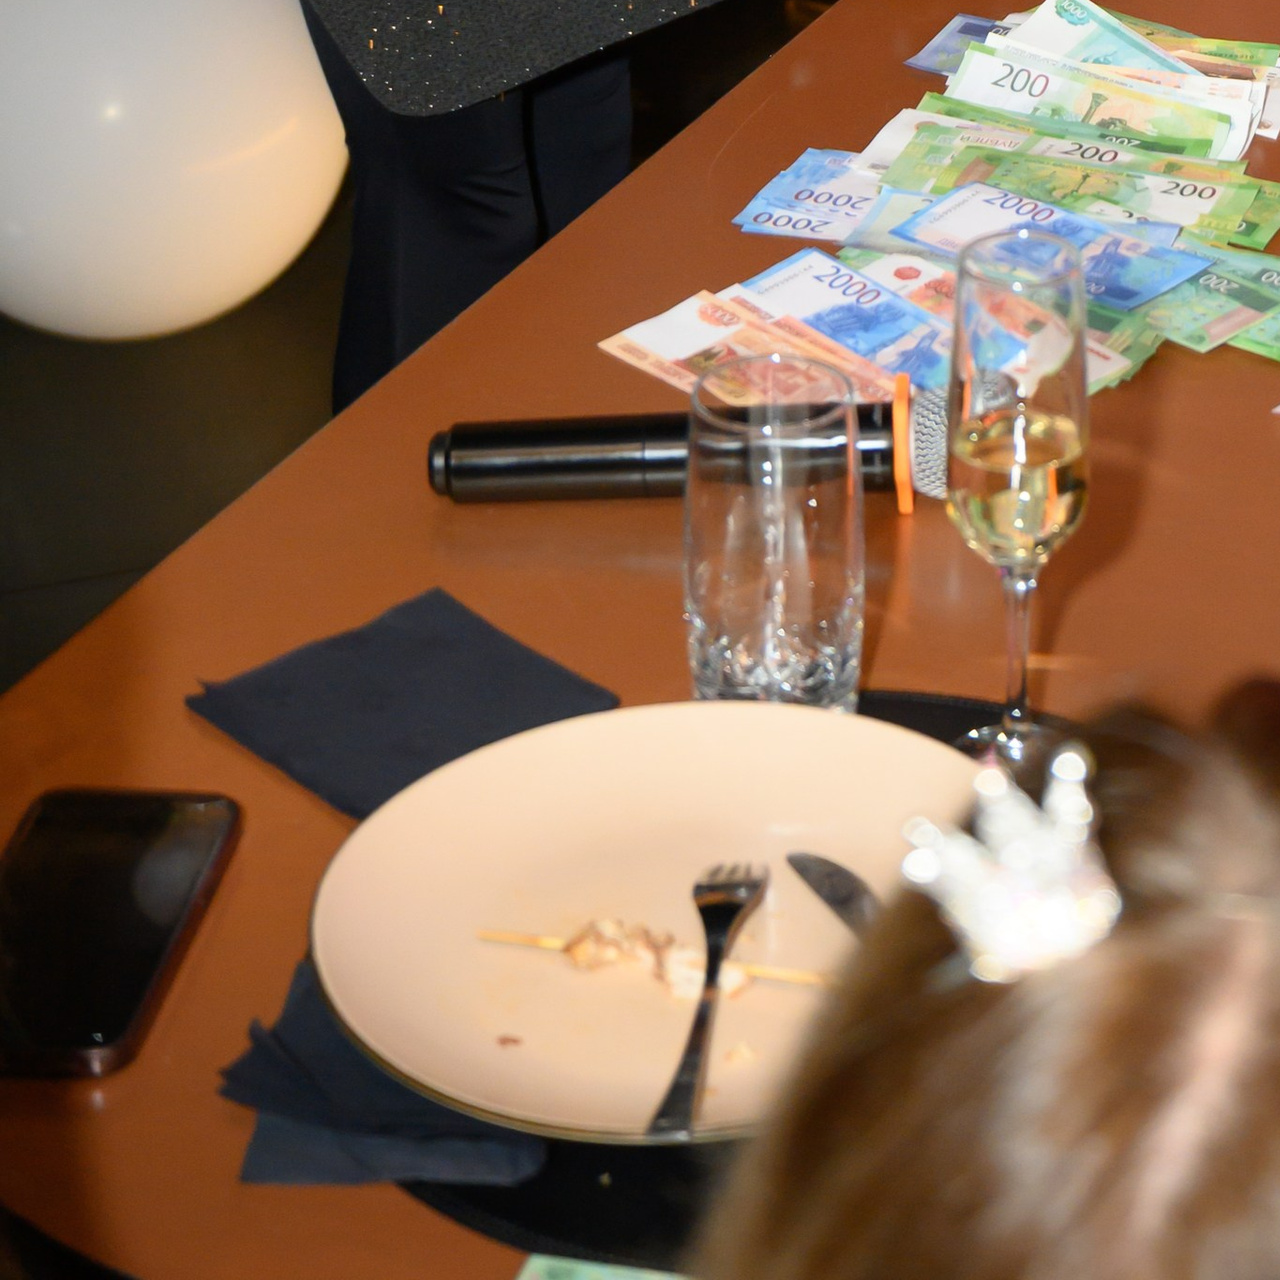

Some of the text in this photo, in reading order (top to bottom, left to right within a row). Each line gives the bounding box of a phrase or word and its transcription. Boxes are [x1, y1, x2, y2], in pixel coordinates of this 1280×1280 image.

[991, 62, 1050, 98] 200
[1060, 141, 1119, 163] 200
[793, 187, 873, 211] 2000
[1161, 180, 1217, 200] 200
[982, 190, 1055, 223] 2000
[752, 211, 832, 234] 2000
[813, 264, 882, 306] 2000
[1199, 273, 1240, 293] 200
